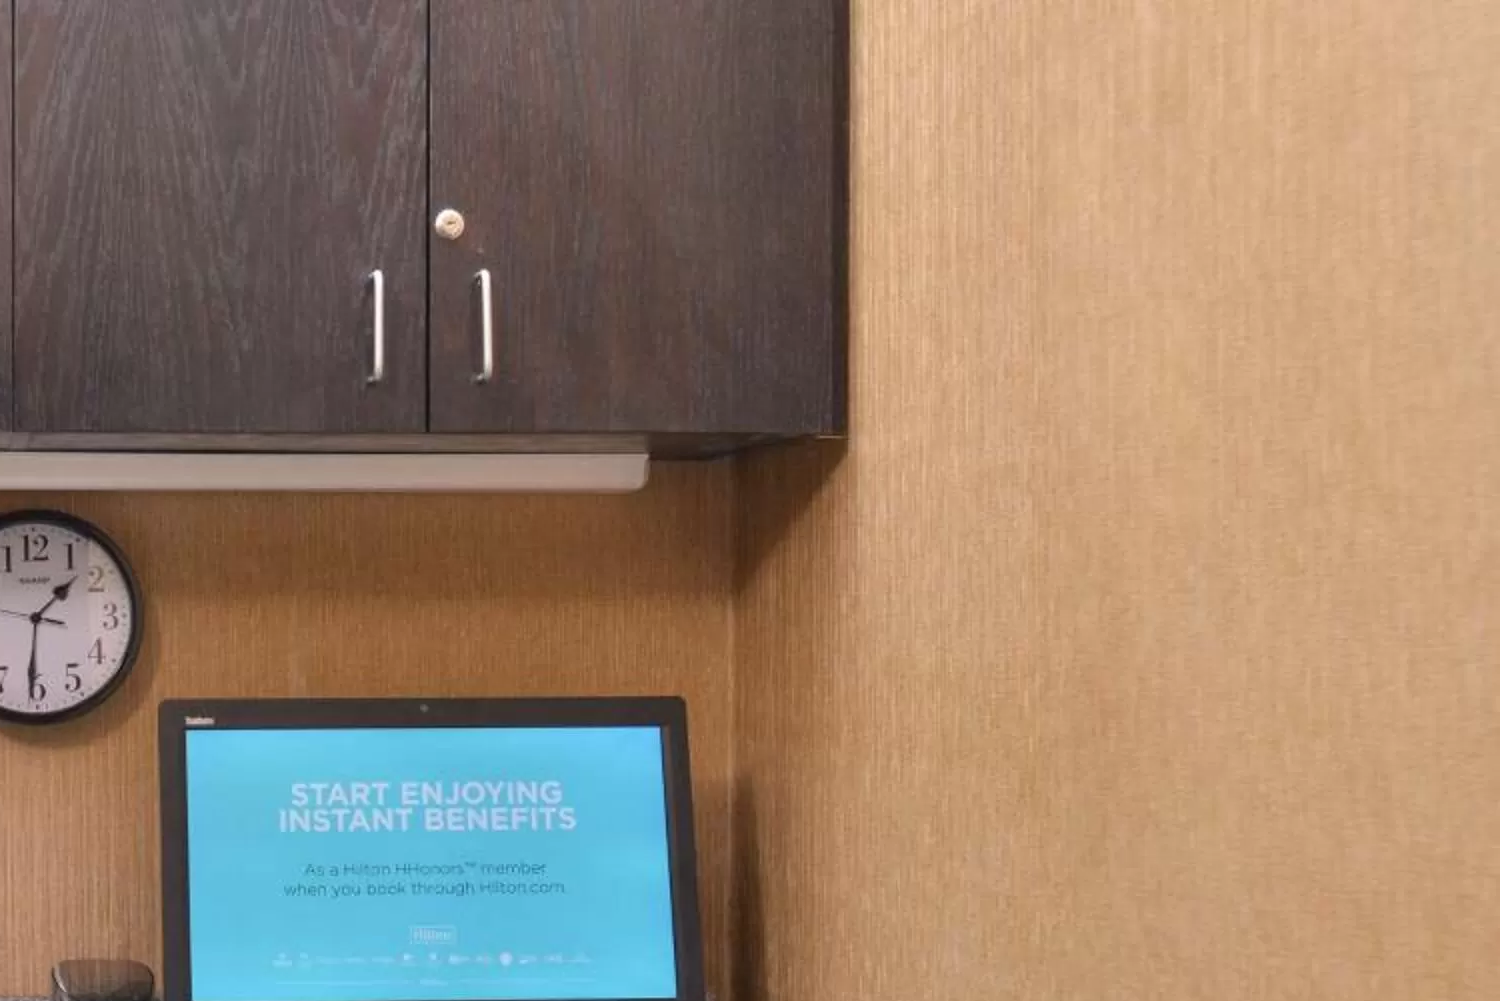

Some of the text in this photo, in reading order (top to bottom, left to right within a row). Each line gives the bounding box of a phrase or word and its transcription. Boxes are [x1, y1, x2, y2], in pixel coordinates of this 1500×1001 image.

[21, 534, 49, 562] 12
[64, 543, 74, 570] 1
[88, 566, 105, 592] 2
[103, 602, 119, 630] 3
[87, 638, 106, 665] 4
[29, 673, 46, 701] 6
[65, 663, 81, 692] 5
[291, 780, 563, 806] START ENJOYING
[279, 807, 577, 833] INSTANT BENEFITS
[304, 863, 325, 876] As
[329, 865, 339, 876] a
[343, 863, 391, 876] Hilton
[481, 862, 547, 876] member
[283, 883, 327, 896] when
[329, 884, 361, 899] you
[367, 882, 405, 896] book
[411, 881, 475, 897] through
